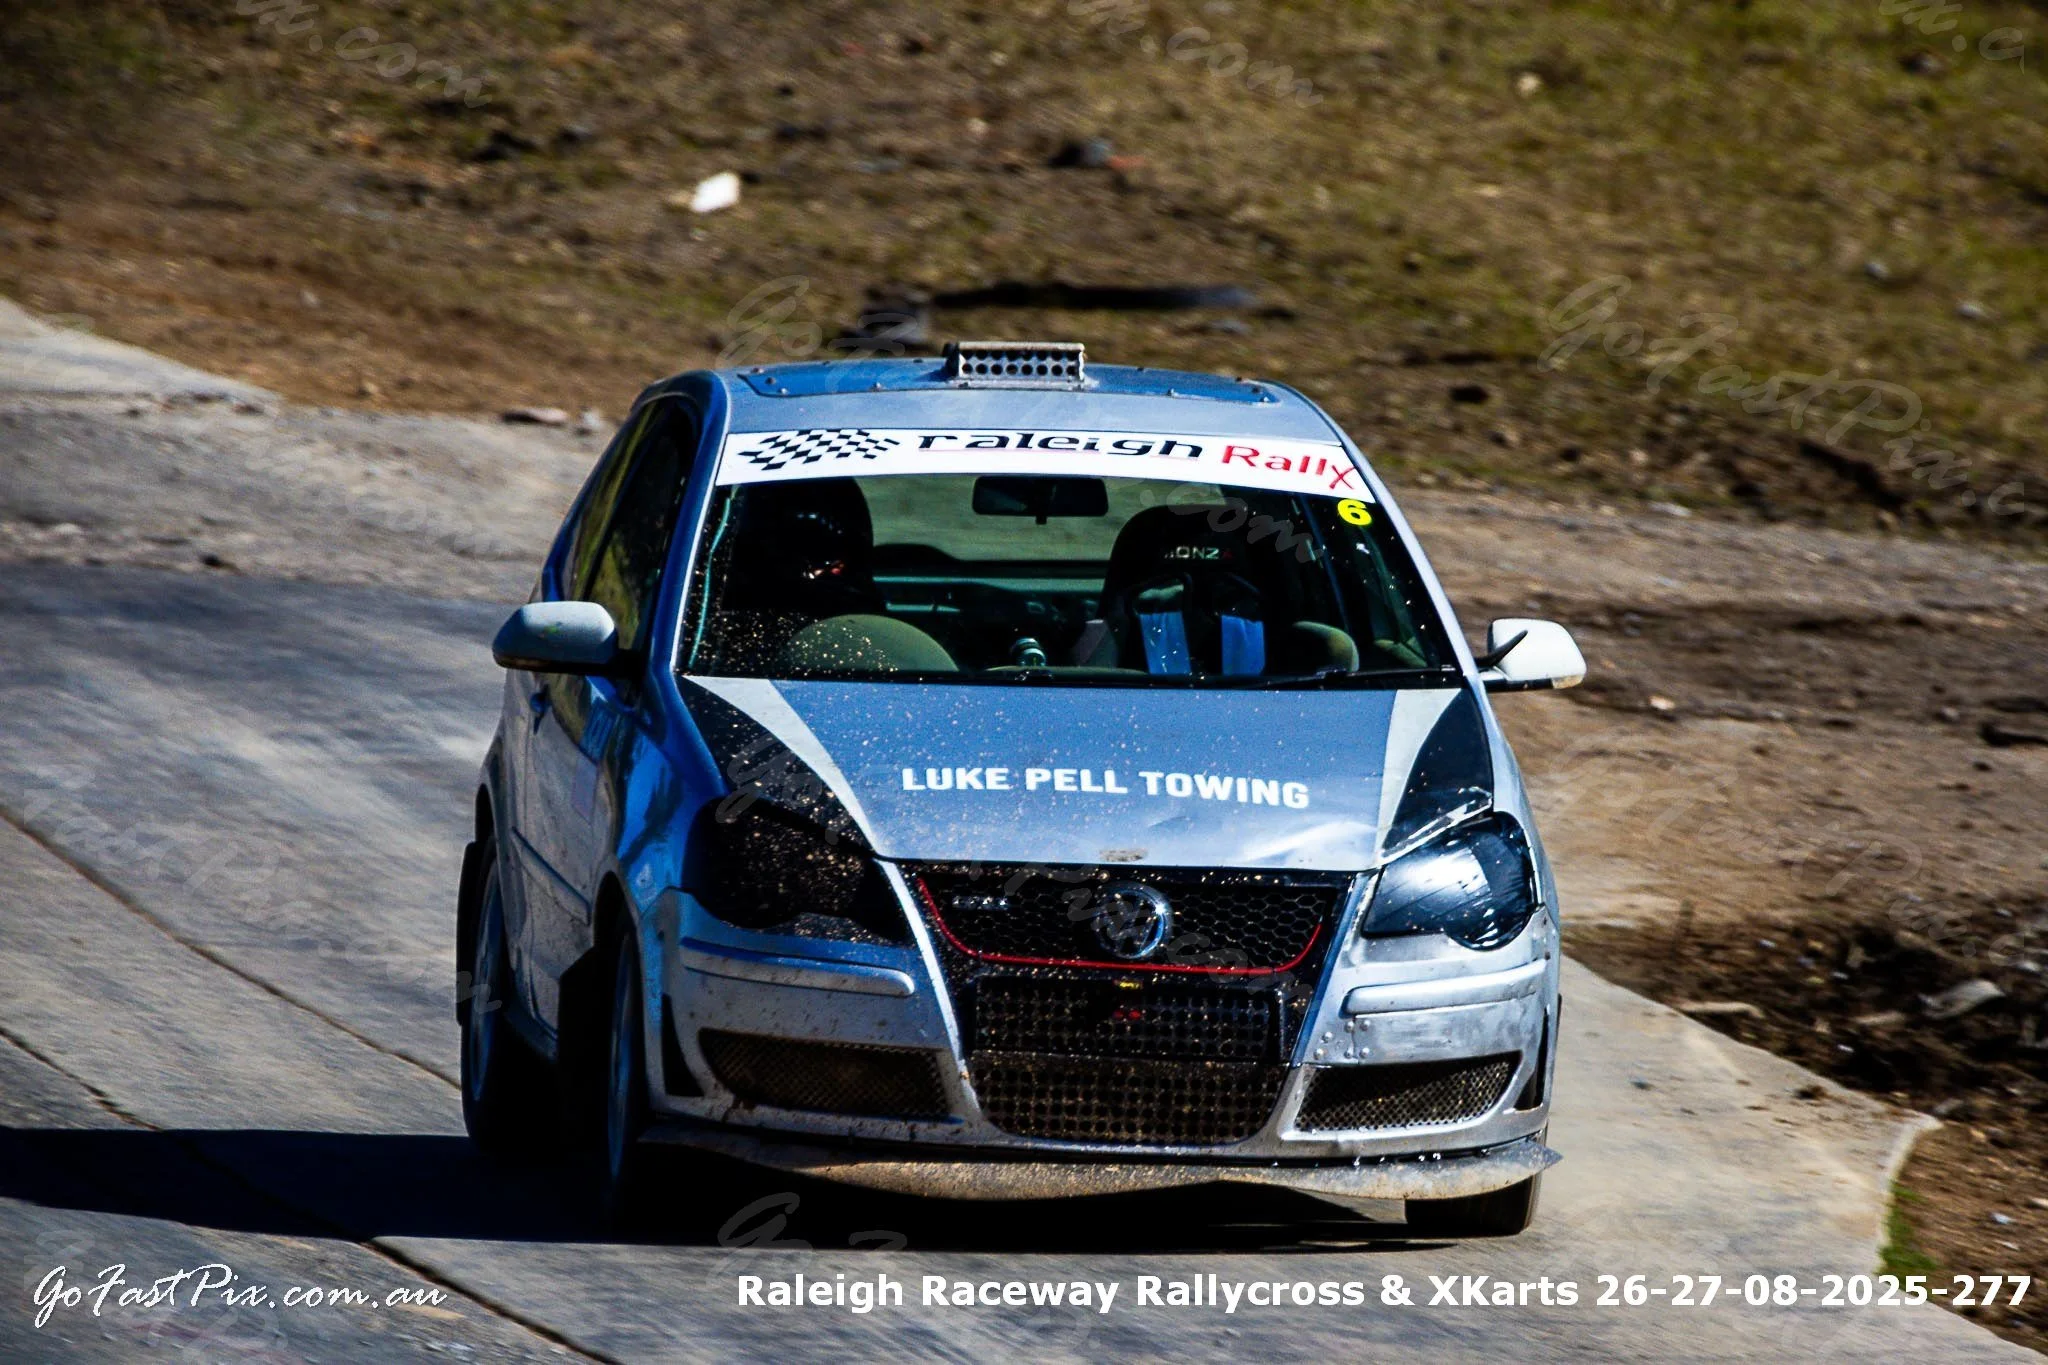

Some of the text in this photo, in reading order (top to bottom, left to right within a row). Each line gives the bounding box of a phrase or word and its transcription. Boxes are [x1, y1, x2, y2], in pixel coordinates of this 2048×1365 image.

[917, 432, 1204, 459] raleigh
[1337, 498, 1372, 526] 6
[903, 767, 1310, 809] LUKE PELL TOWING
